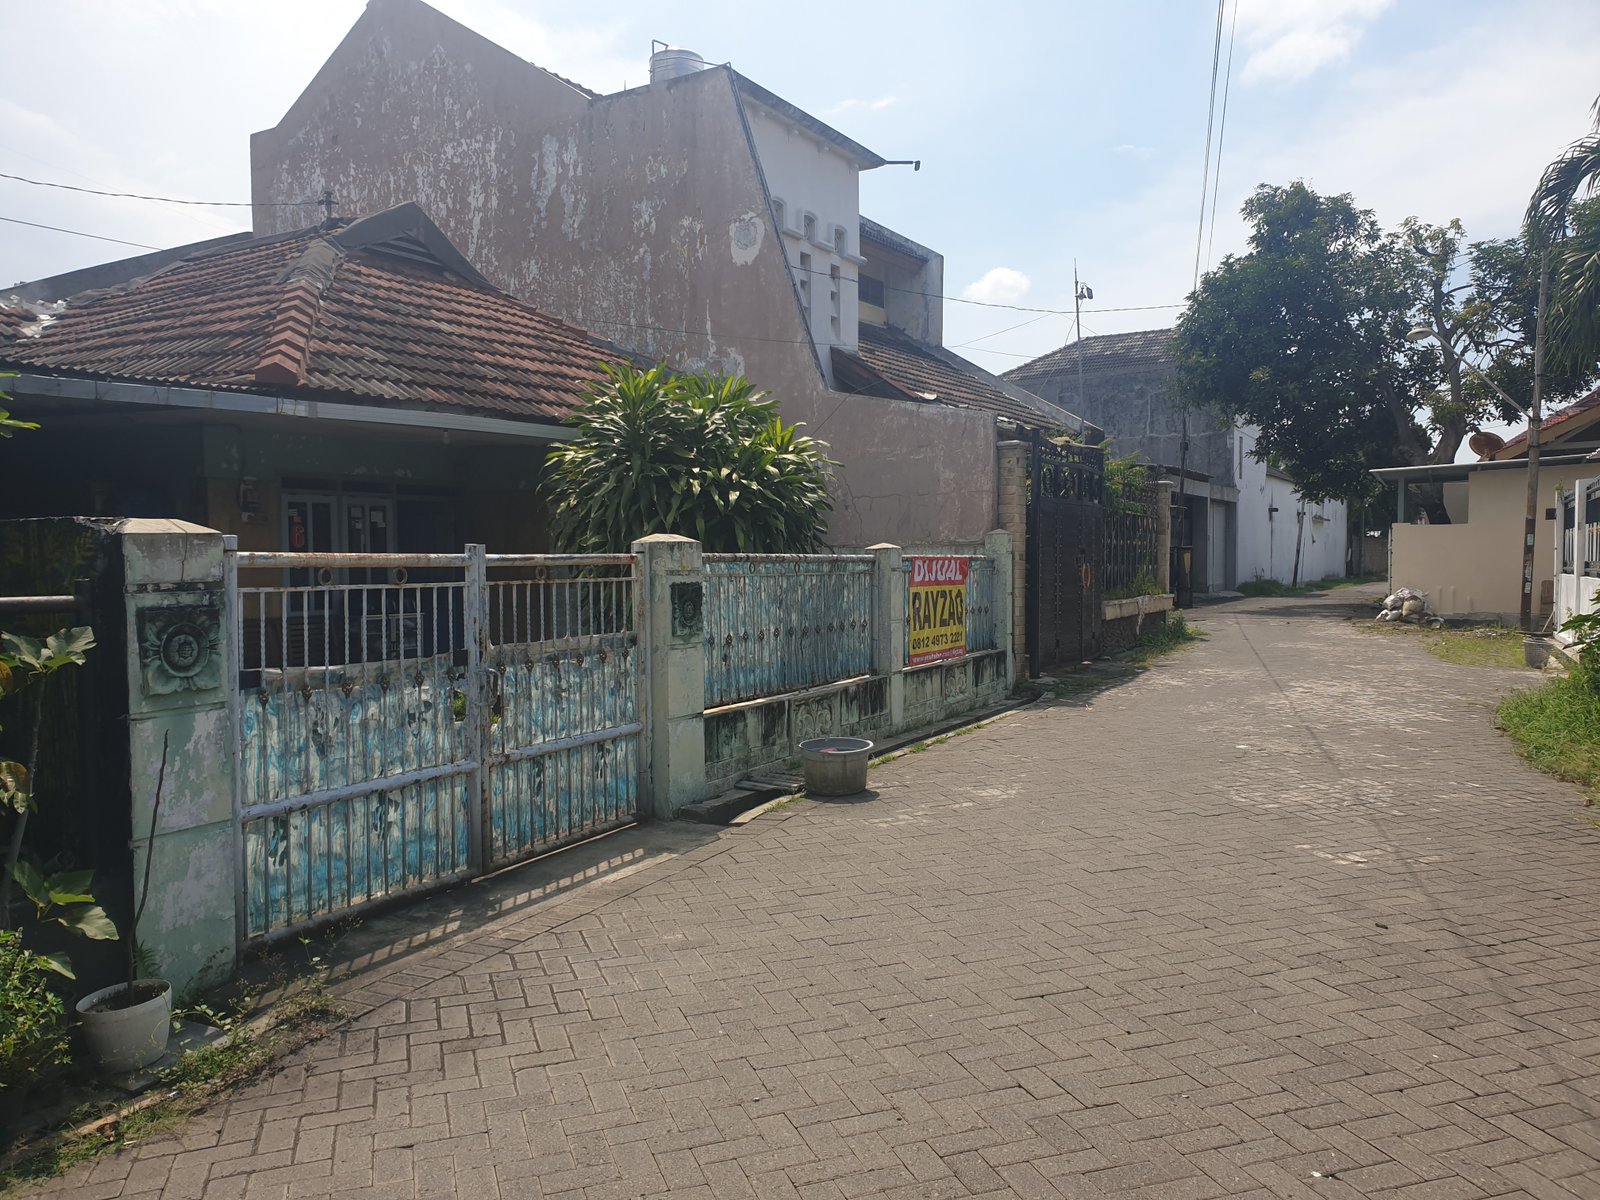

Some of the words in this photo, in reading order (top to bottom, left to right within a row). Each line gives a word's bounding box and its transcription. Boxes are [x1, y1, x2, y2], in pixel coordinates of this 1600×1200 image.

[914, 560, 962, 581] DIJUAL
[912, 589, 963, 631] RAYZAQ
[912, 637, 930, 650] 0812
[931, 634, 949, 647] 4973
